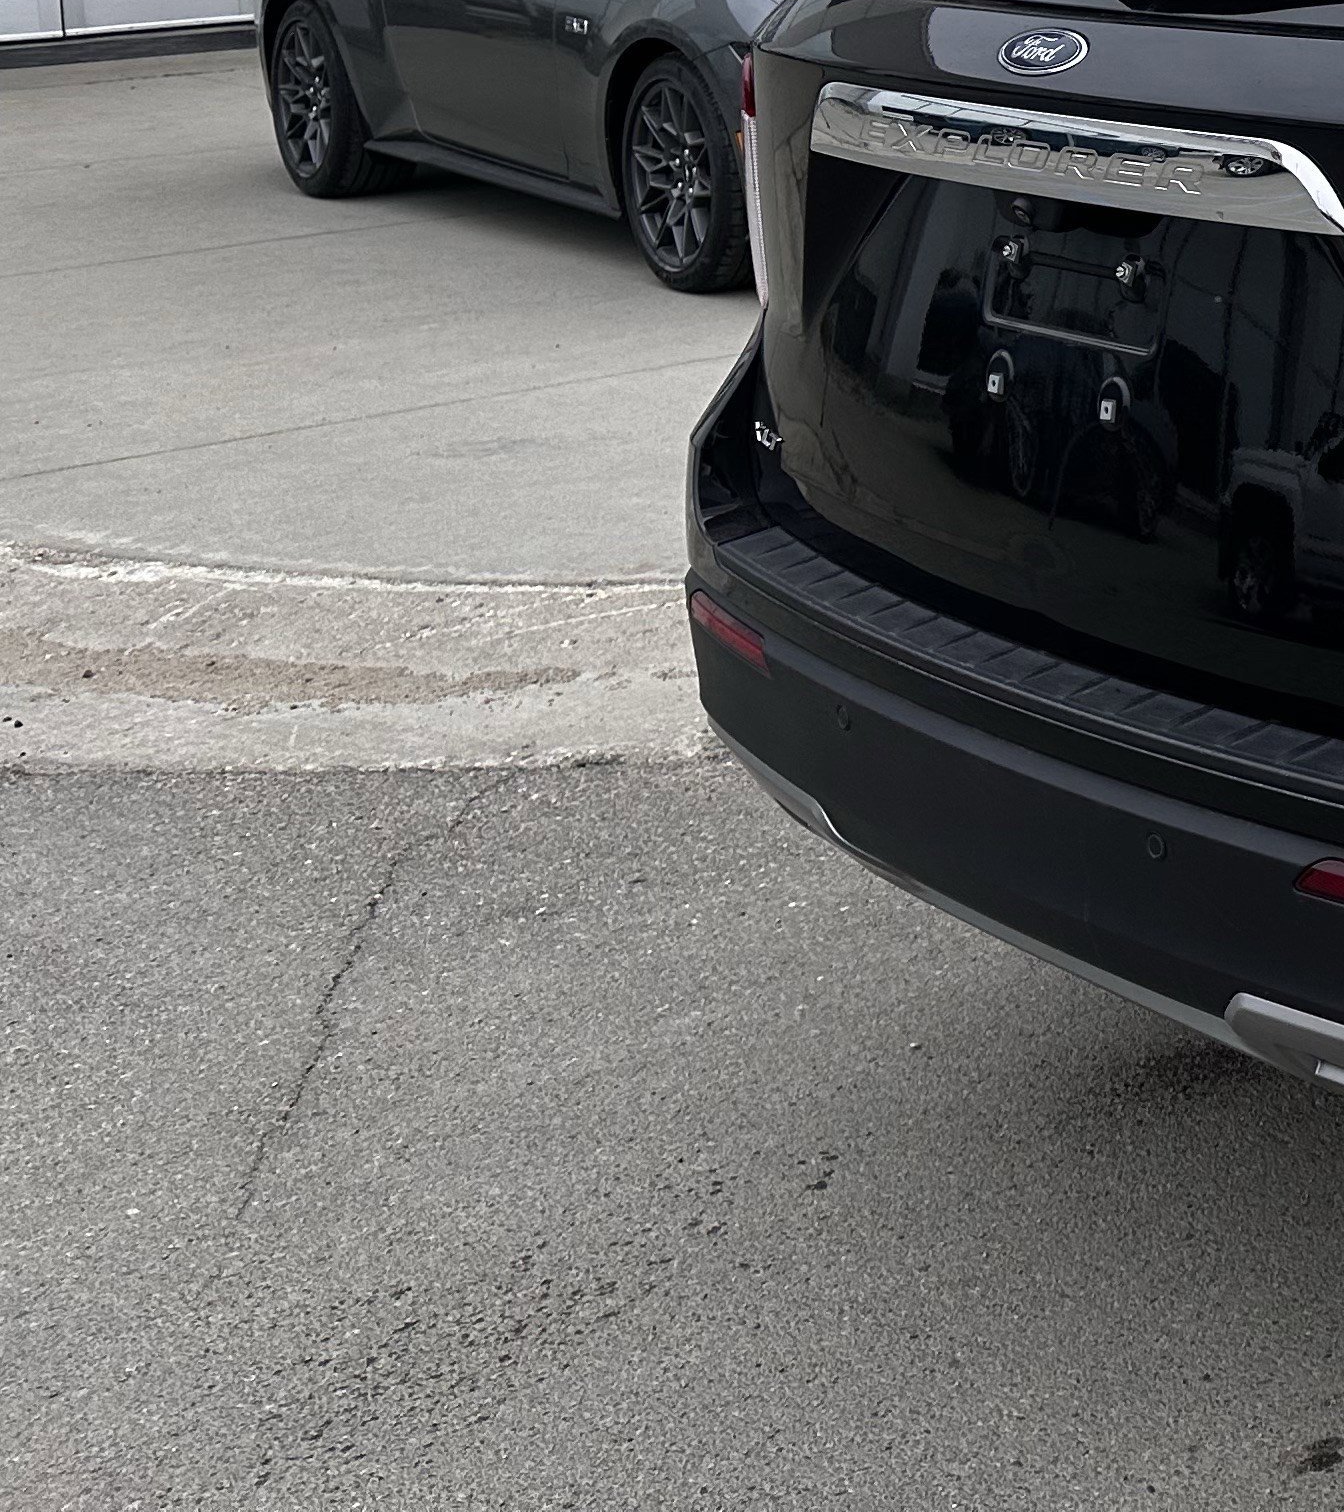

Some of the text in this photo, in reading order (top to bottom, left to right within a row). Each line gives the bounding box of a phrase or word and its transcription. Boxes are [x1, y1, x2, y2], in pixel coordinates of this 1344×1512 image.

[1011, 34, 1065, 62] Ford
[858, 119, 1205, 195] EXPLORER
[754, 421, 783, 450] XLT
